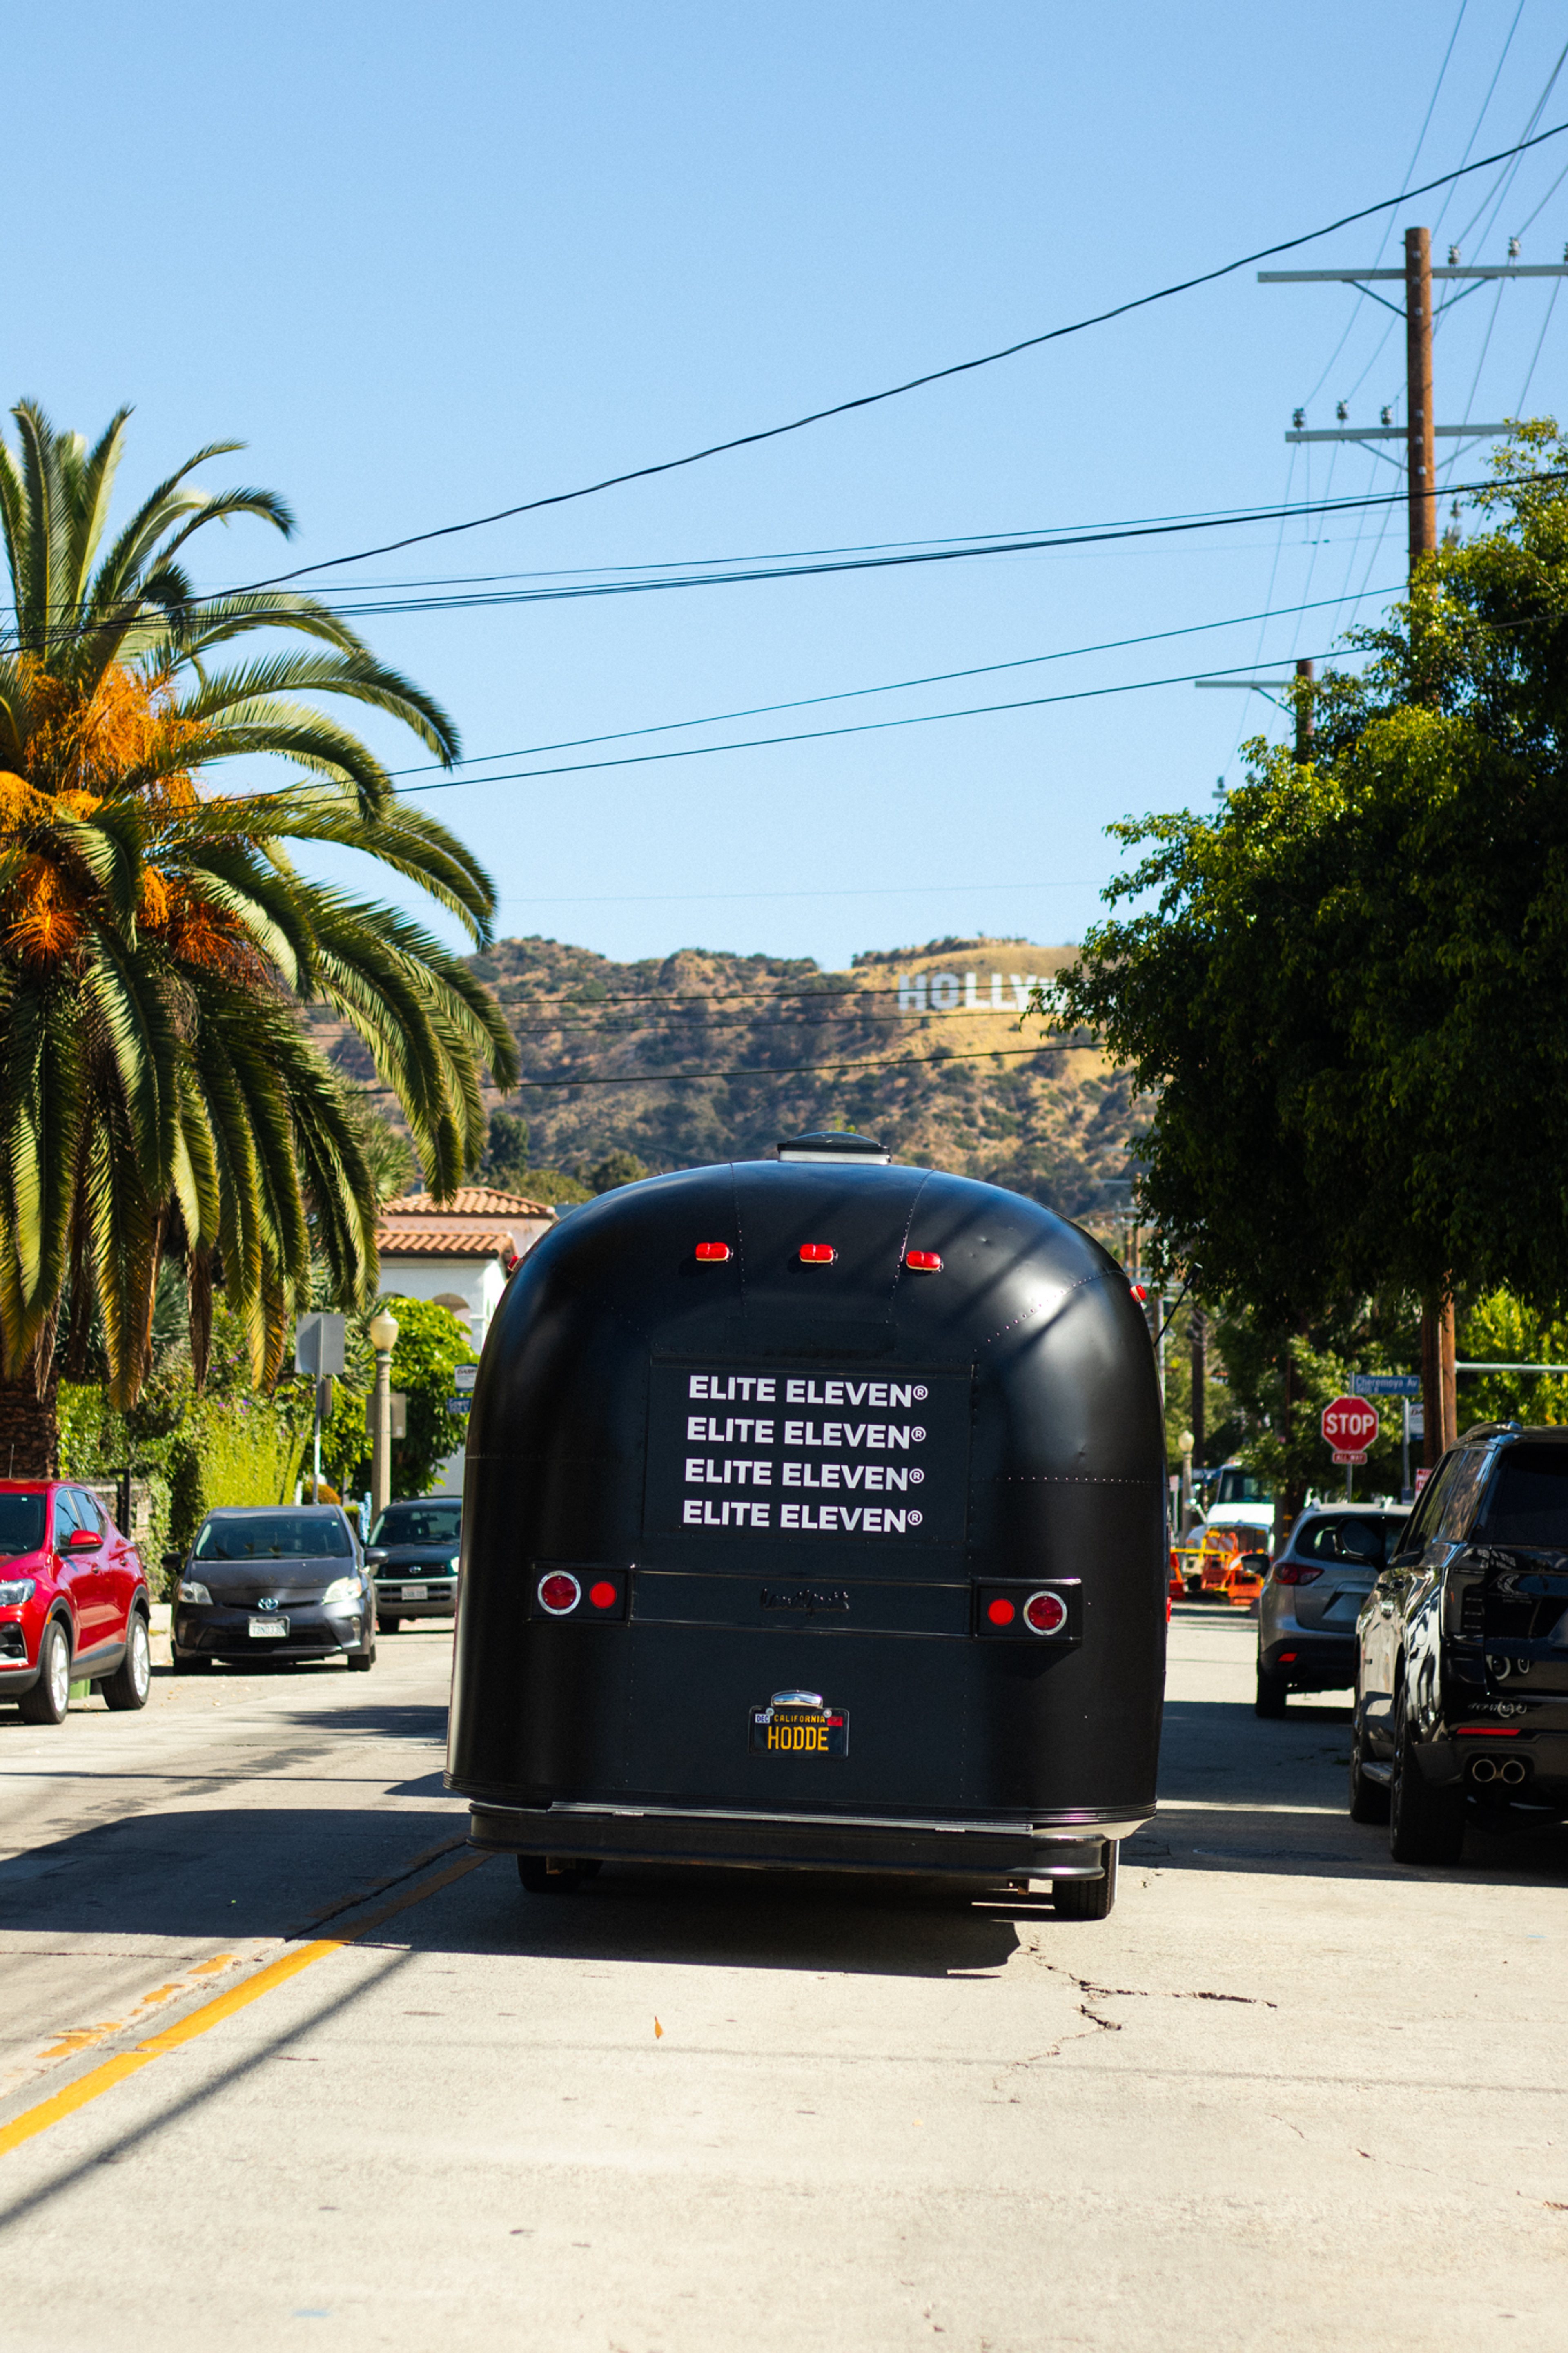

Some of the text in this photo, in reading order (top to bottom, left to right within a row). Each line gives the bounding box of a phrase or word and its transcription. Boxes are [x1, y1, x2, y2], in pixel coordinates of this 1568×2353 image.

[689, 1375, 928, 1407] ELITE ELEVEN®
[1356, 1376, 1418, 1389] Cheremoya Av
[687, 1416, 926, 1449] ELITE ELEVEN®
[1326, 1413, 1374, 1436] STOP
[685, 1458, 924, 1491] ELITE ELEVEN®
[683, 1500, 923, 1533] ELITE ELEVEN®
[774, 1714, 826, 1723] CALIFORNIA
[768, 1726, 829, 1751] HODDE
